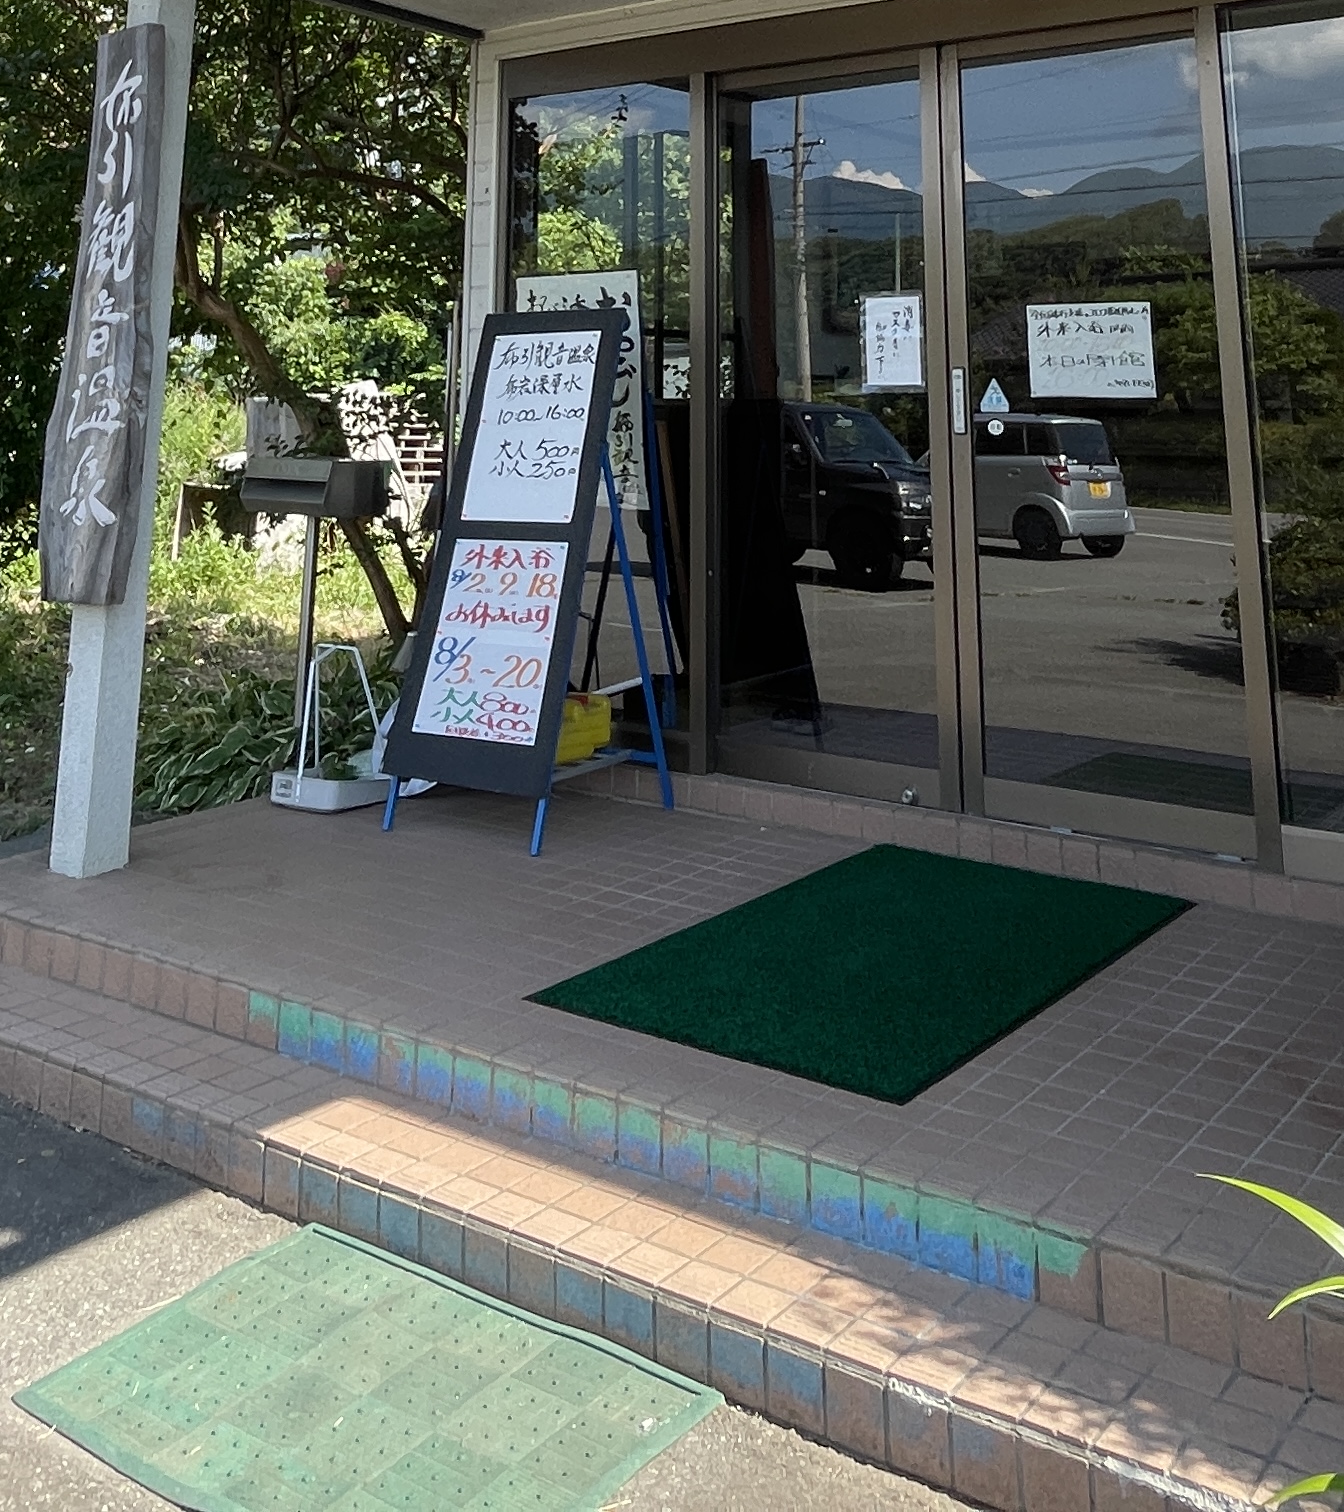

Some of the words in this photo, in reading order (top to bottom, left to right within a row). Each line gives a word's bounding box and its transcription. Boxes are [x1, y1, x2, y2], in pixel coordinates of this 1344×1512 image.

[59, 58, 143, 528] 布引観音温泉
[493, 340, 595, 371] 布引観音温泉
